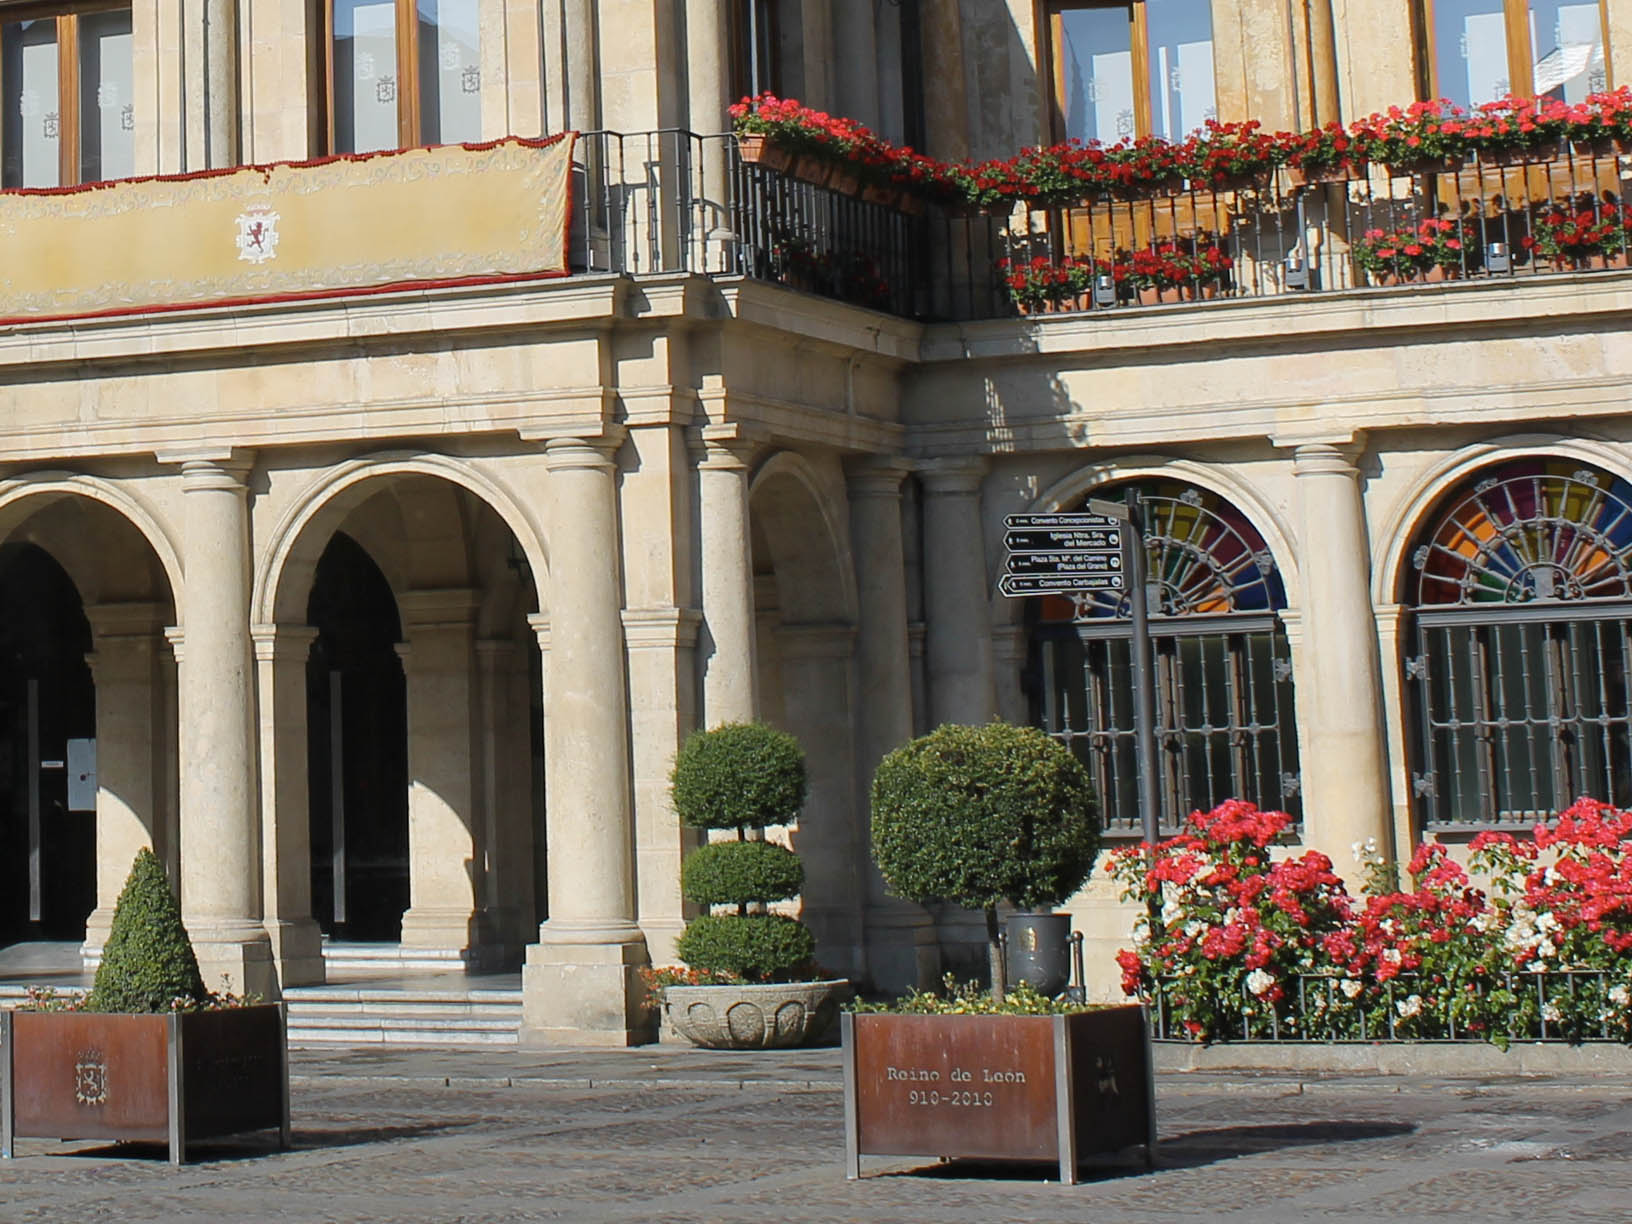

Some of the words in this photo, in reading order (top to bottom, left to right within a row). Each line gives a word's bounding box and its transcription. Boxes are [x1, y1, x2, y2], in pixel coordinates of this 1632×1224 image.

[1076, 539, 1107, 547] Mercado
[1031, 555, 1048, 563] Plaza
[1083, 554, 1107, 562] Camino
[1038, 579, 1072, 587] Convento
[887, 1067, 940, 1081] Reino
[950, 1068, 972, 1082] de
[909, 1090, 993, 1107] 910-2010
